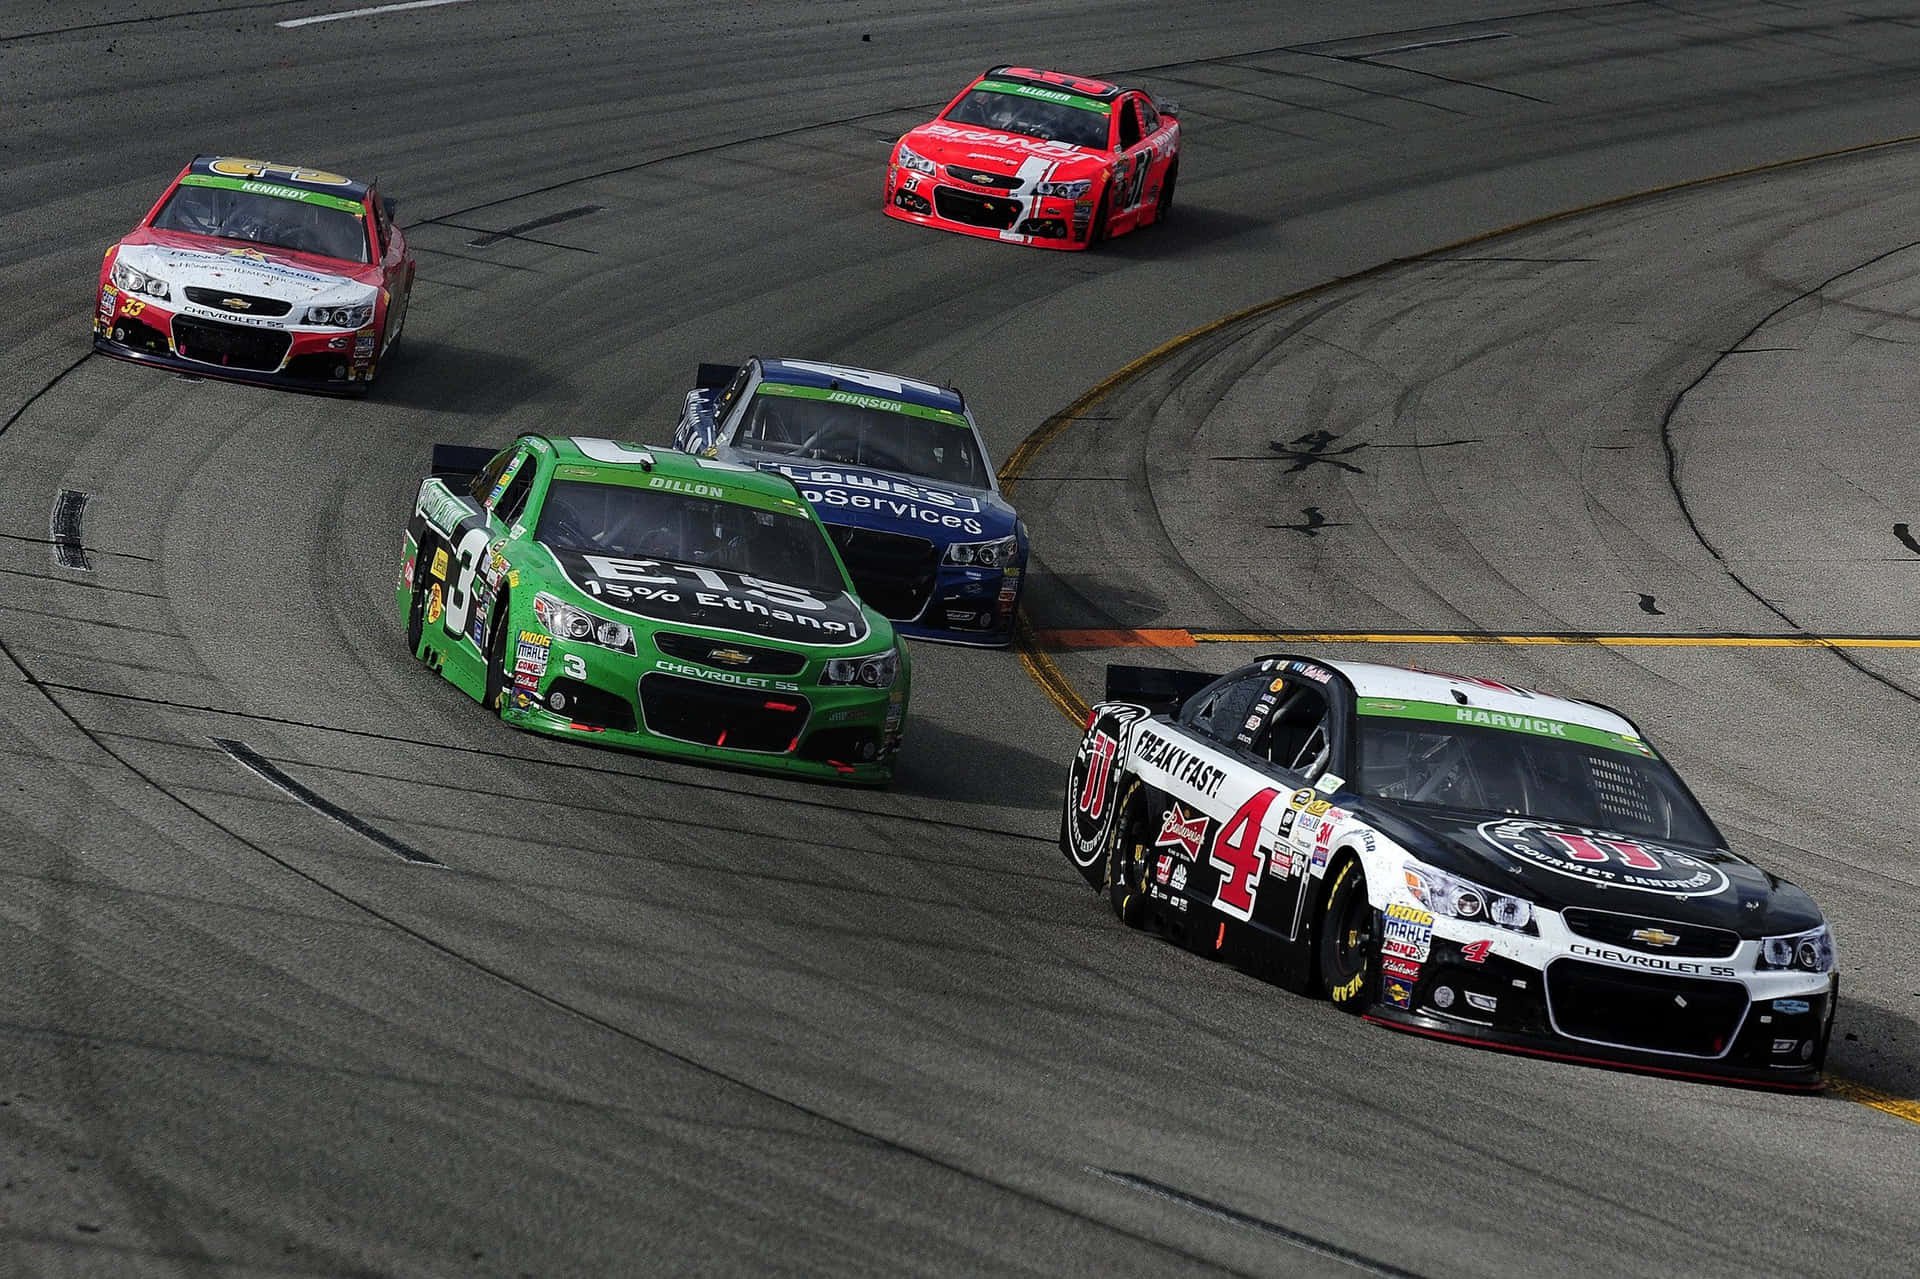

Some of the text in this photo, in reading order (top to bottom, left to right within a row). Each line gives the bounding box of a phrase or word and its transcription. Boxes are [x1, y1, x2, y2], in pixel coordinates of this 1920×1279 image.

[1016, 85, 1071, 101] ALLGAIER
[241, 182, 310, 199] KENNEDY
[905, 178, 919, 190] 51
[121, 298, 146, 316] 33
[184, 306, 263, 325] CHEVROLET
[827, 392, 902, 412] JOHNSON
[649, 477, 723, 498] DILLON
[801, 489, 982, 535] oServices
[446, 528, 490, 634] 3
[582, 554, 827, 611] E15
[584, 579, 857, 638] 15% Ethanol
[520, 631, 552, 647] MOOG
[519, 644, 548, 661] MAHLE
[564, 653, 587, 680] 3
[656, 660, 799, 691] CHEVROLET SS
[1456, 708, 1566, 736] HARVICK
[1133, 729, 1228, 799] FREAKY FAST!
[1316, 822, 1335, 846] 3M
[1209, 787, 1281, 922] 4
[1512, 843, 1617, 880] GOURMET
[1386, 903, 1433, 925] MOOG
[1386, 921, 1431, 943] MAHLE
[1461, 939, 1494, 963] 4
[1569, 944, 1736, 977] CHEVROLET SS
